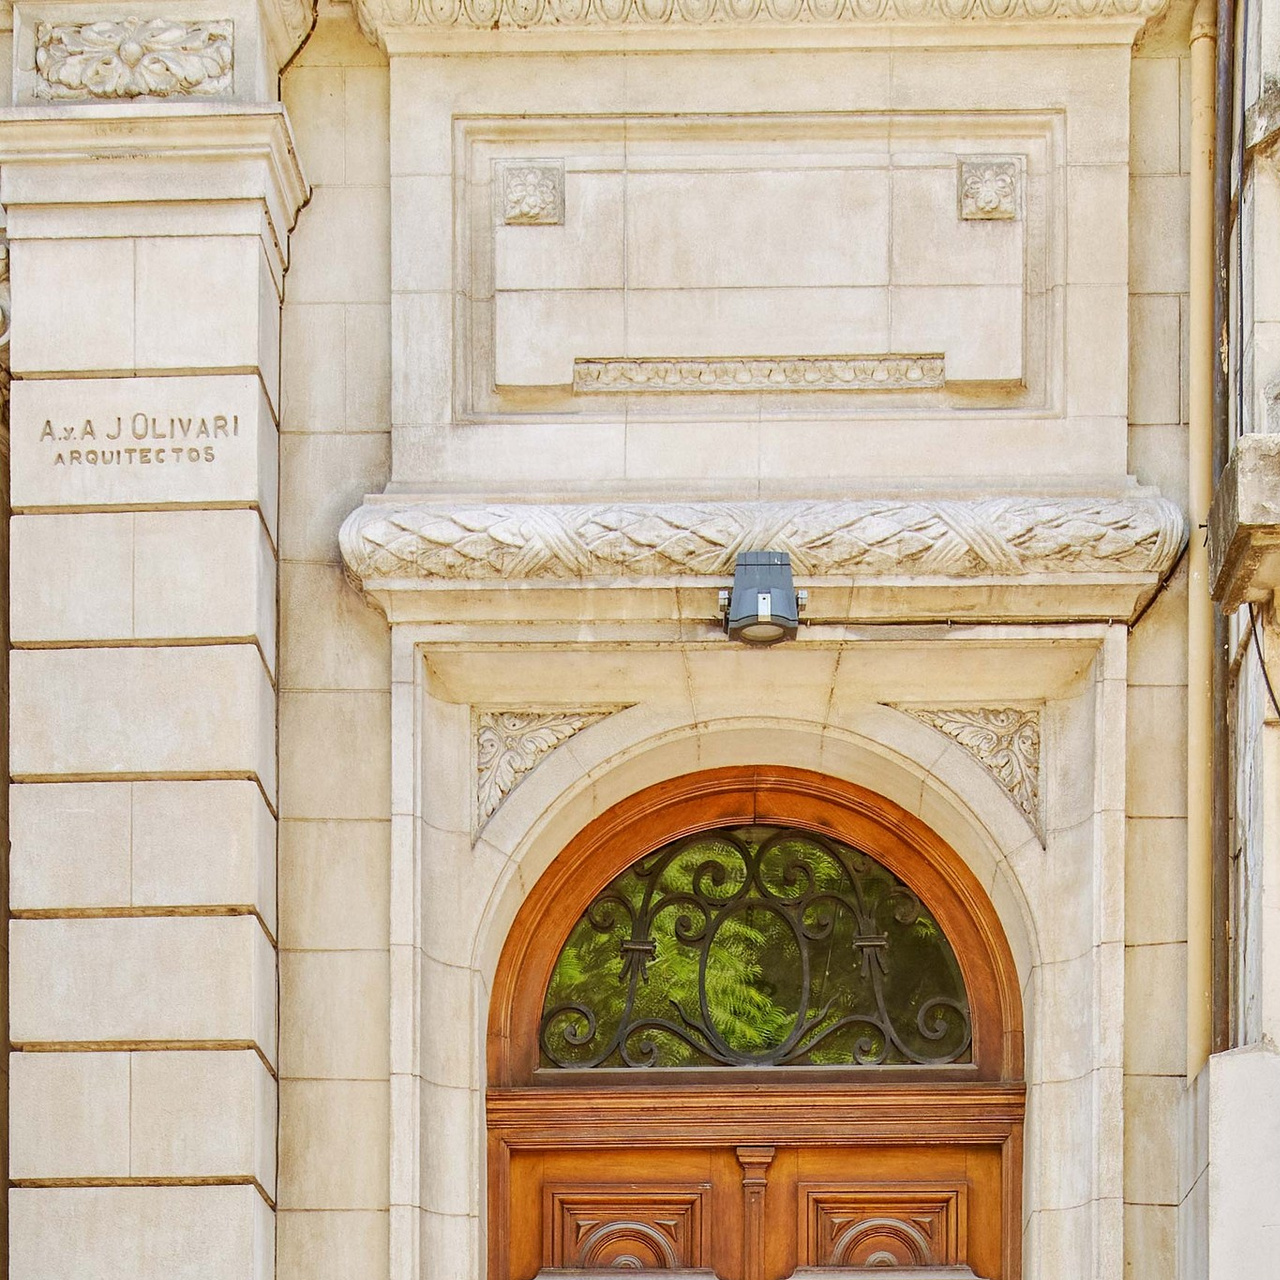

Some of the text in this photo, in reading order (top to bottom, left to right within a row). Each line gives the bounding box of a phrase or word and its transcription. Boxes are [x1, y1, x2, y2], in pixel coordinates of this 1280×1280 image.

[106, 417, 121, 440] J
[131, 412, 239, 440] OLIVARI
[54, 446, 215, 466] ARQUITECTOS
